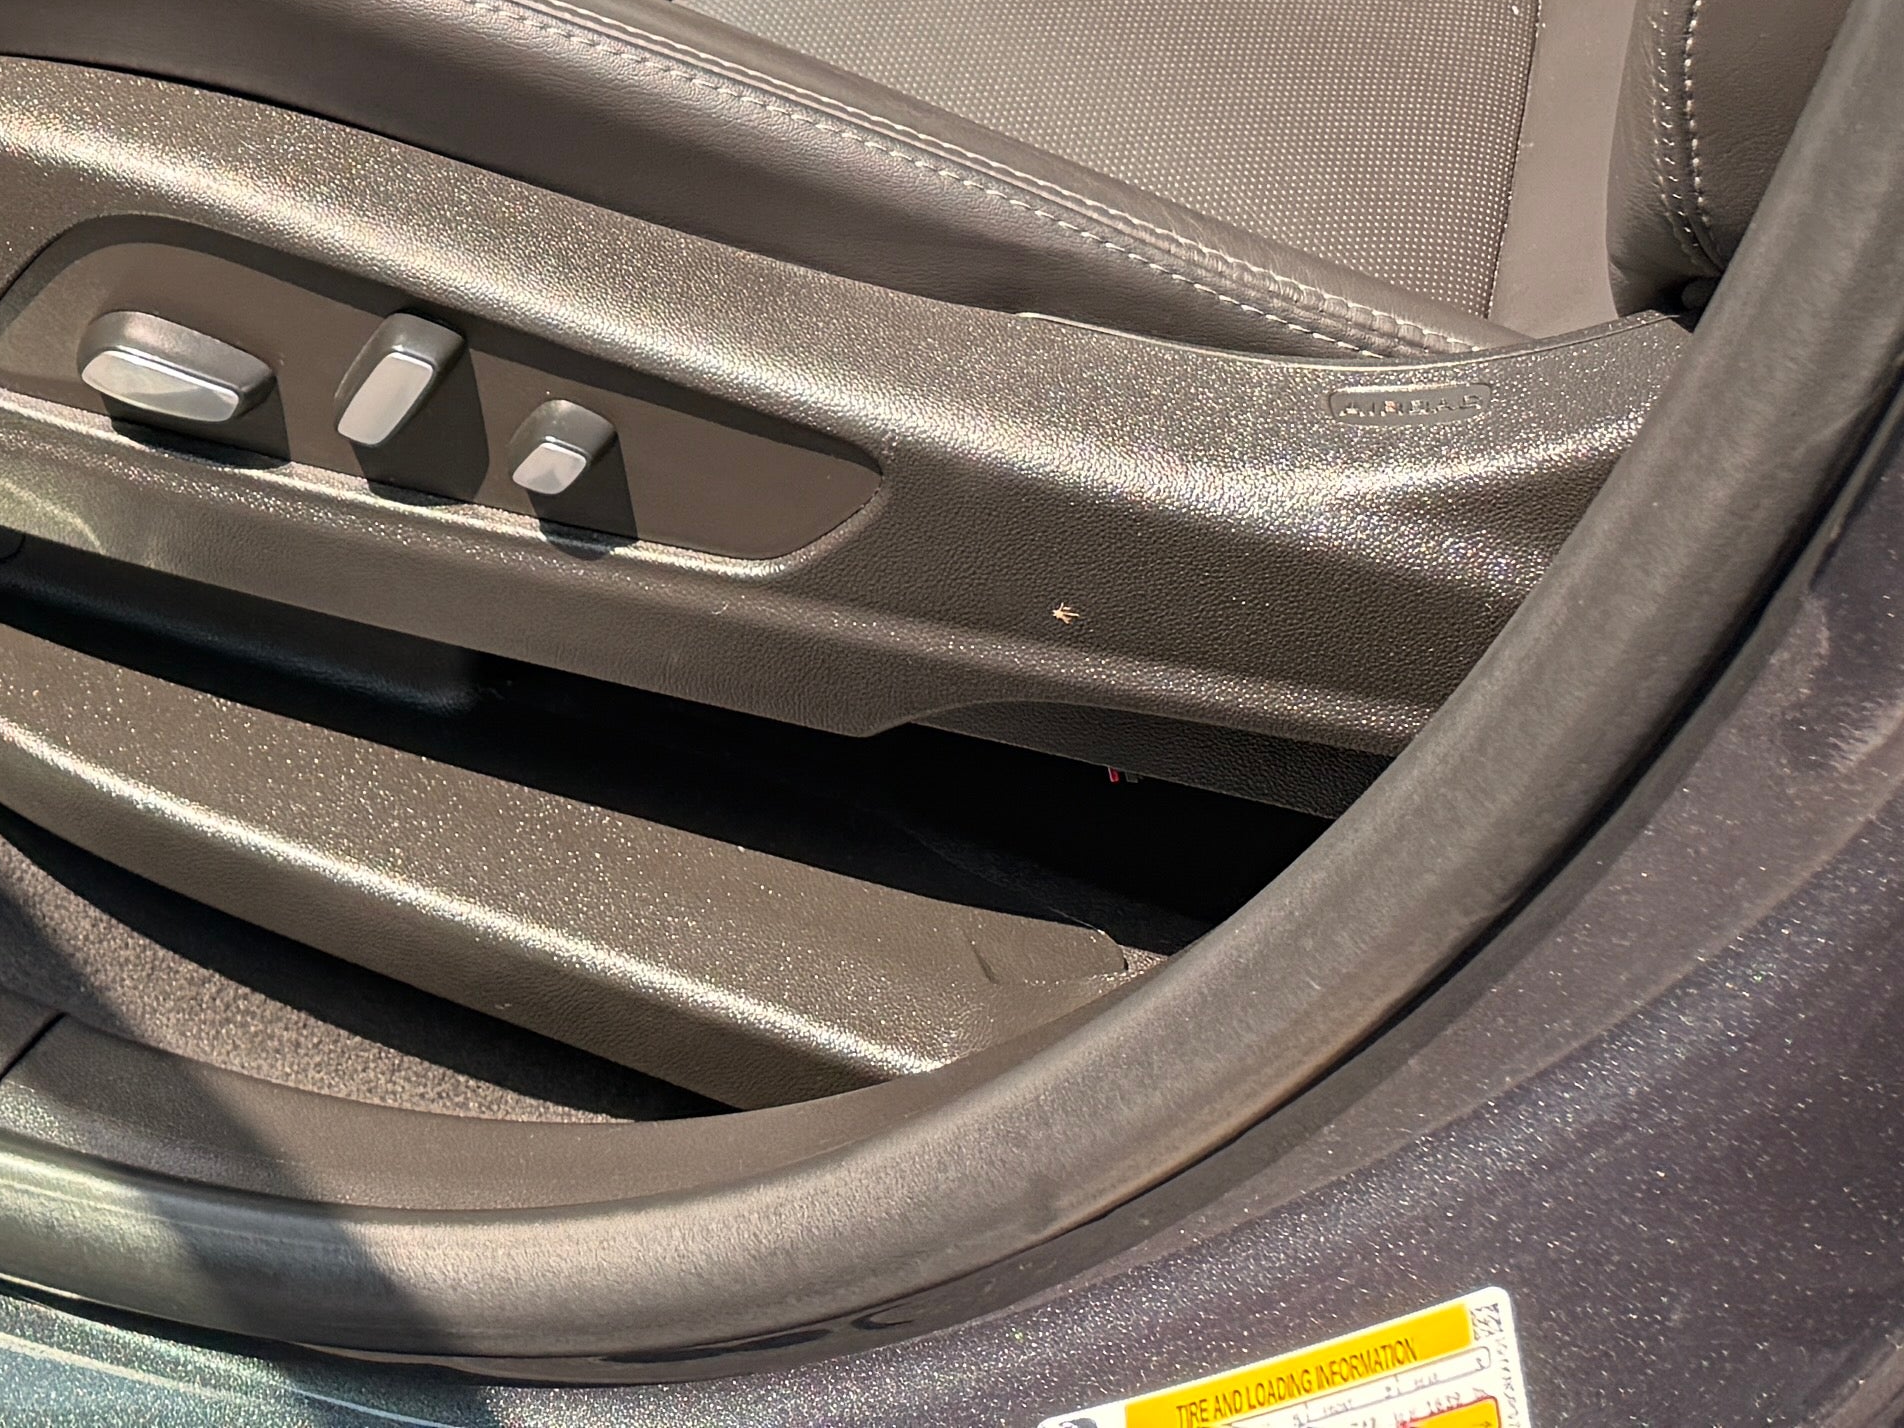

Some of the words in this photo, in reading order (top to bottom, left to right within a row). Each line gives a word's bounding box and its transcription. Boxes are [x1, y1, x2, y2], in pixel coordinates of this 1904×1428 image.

[1339, 394, 1483, 417] AIRBAG
[1176, 1398, 1210, 1428] TIRE
[1213, 1389, 1243, 1420] AND
[1246, 1368, 1313, 1411] LOADING
[1315, 1338, 1418, 1391] INFORMATION
